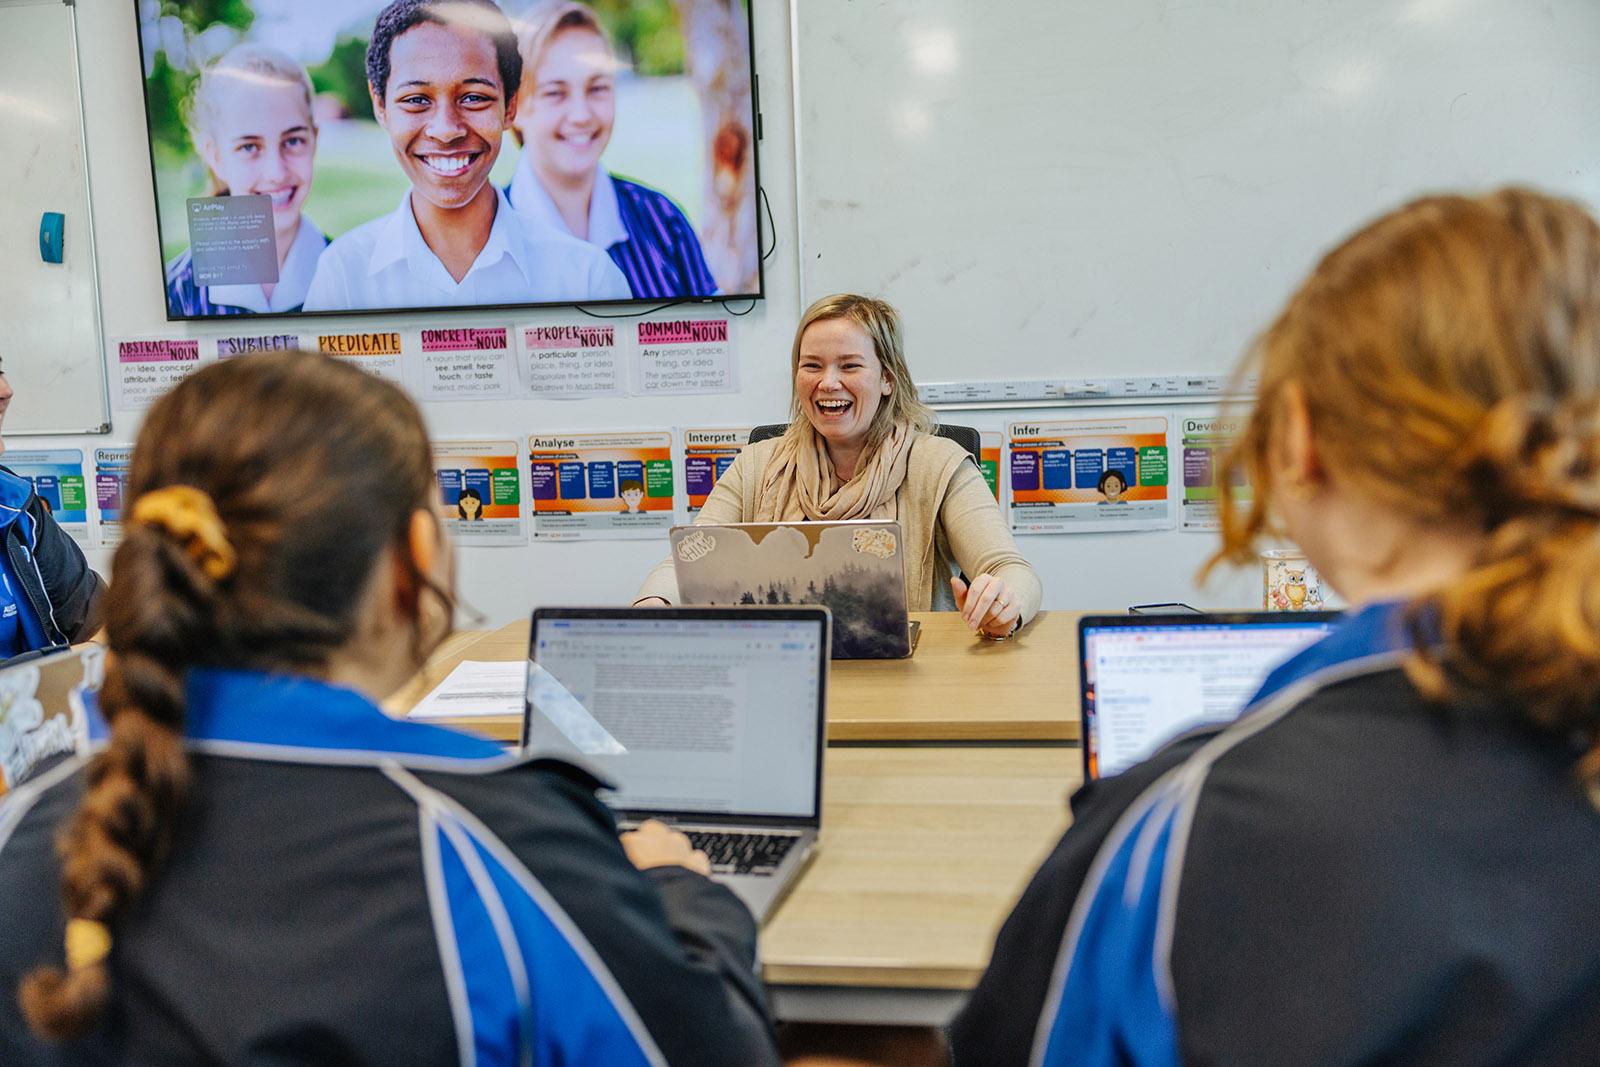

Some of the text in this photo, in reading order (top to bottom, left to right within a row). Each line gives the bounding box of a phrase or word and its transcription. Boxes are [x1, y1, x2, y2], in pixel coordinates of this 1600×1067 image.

[203, 203, 224, 212] AirPlay
[537, 326, 614, 347] PROPER NOUN
[638, 320, 727, 341] COMMON NOUN
[229, 335, 290, 353] SUBJECT
[319, 333, 399, 352] PREDICATE
[421, 328, 507, 349] CONCRETE NOUN
[119, 340, 199, 361] ABSTRACT NOUN
[539, 351, 577, 360] particular
[643, 349, 660, 358] Any
[1013, 425, 1040, 436] Infer
[534, 438, 575, 449] Analyse
[688, 433, 737, 443] Interpret
